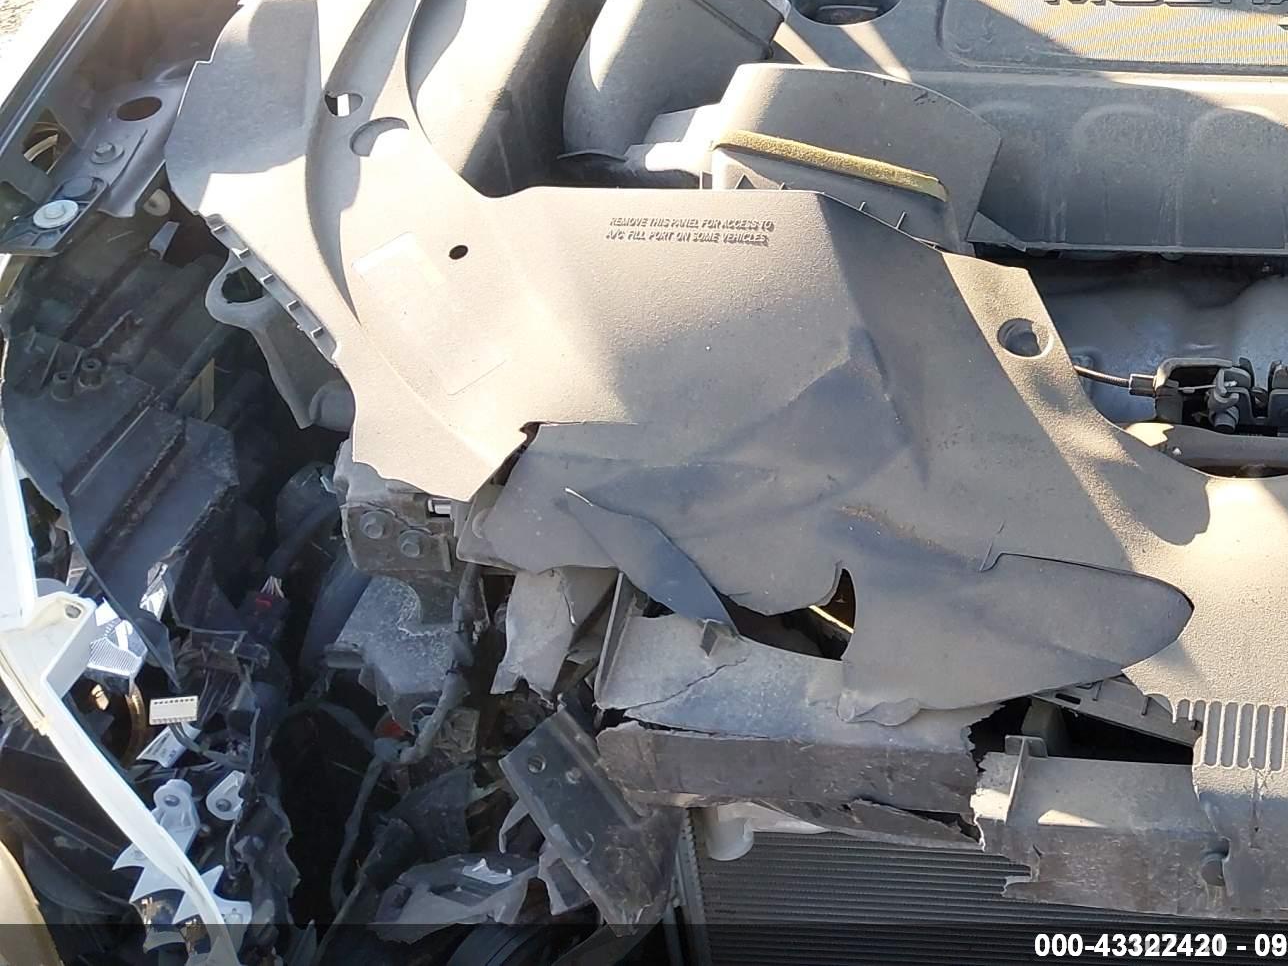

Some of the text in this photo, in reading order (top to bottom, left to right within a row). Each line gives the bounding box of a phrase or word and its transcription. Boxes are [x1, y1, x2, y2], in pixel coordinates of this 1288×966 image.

[609, 217, 775, 232] REMOVE THIS PANEL FOR ACCESS TO
[606, 229, 769, 247] A/C FILL PORT ON SOME VEHICLES
